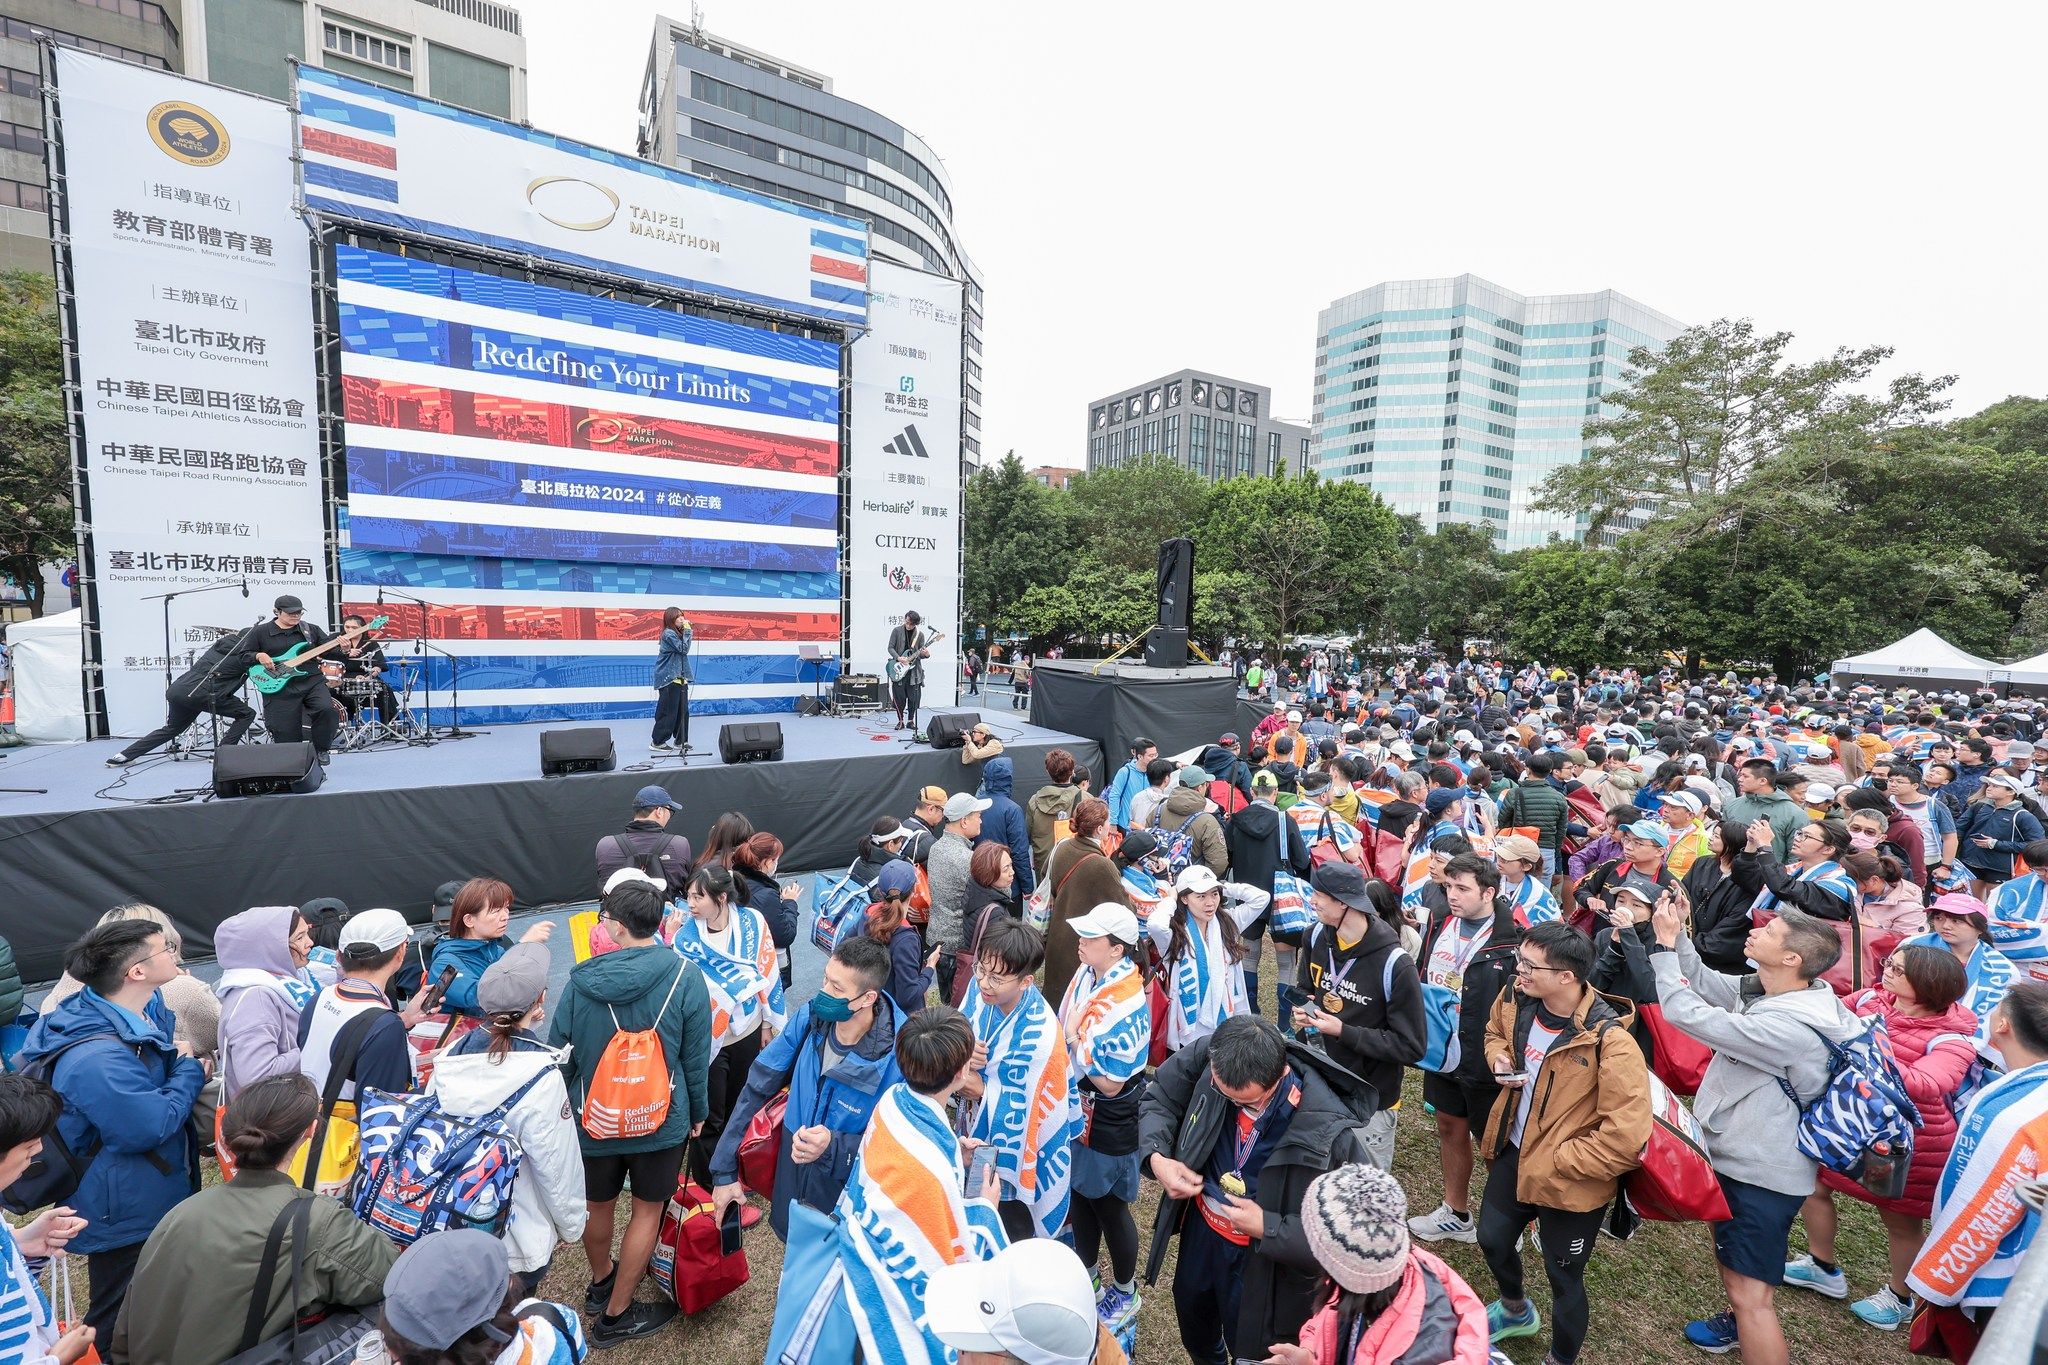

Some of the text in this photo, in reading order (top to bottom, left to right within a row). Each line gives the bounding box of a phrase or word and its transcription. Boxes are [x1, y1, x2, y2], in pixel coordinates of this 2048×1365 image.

[172, 141, 208, 153] ATHLETICS
[177, 137, 203, 147] WORLD
[153, 182, 232, 212] 指導單位
[629, 205, 684, 230] TAIPEI
[112, 208, 274, 257] 教育部體育署
[629, 221, 721, 253] MARATHON
[112, 232, 139, 244] Sports
[201, 249, 230, 260] Ministry
[240, 255, 276, 268] Education
[162, 286, 240, 311] 主辦單位
[133, 318, 267, 356] 臺北市政府
[133, 342, 269, 368] Taipei City Government
[888, 344, 927, 361] 頂級贊助
[479, 340, 751, 404] Redefine Your Limits
[96, 377, 306, 418] 中華民國田徑協會
[884, 392, 929, 410] 富邦金控
[96, 400, 307, 430] Chinese Taipei Athletics Association
[884, 405, 929, 418] Fubon Financial
[626, 426, 655, 436] TAIPEI
[626, 435, 674, 446] MARATHON
[100, 441, 308, 477] 中華民國路跑協會
[103, 465, 308, 488] Chinese Taipei Road Running Association
[887, 472, 926, 486] 主要贊助
[520, 479, 723, 510] 臺北馬拉松2024 #從心定義
[863, 499, 911, 515] Herbalife
[922, 505, 948, 518] 賀寶芙
[176, 519, 251, 538] 承辦單位
[875, 534, 936, 551] CITIZEN
[109, 550, 314, 576] 臺北市政府體育局
[109, 573, 316, 587] Department of Sports, Taipei City Government
[624, 1099, 667, 1117] Redefine
[624, 1114, 650, 1125] Your
[624, 1119, 657, 1133] Limits
[451, 1128, 477, 1150] TAIPEI
[365, 1163, 389, 1214] MARATHON
